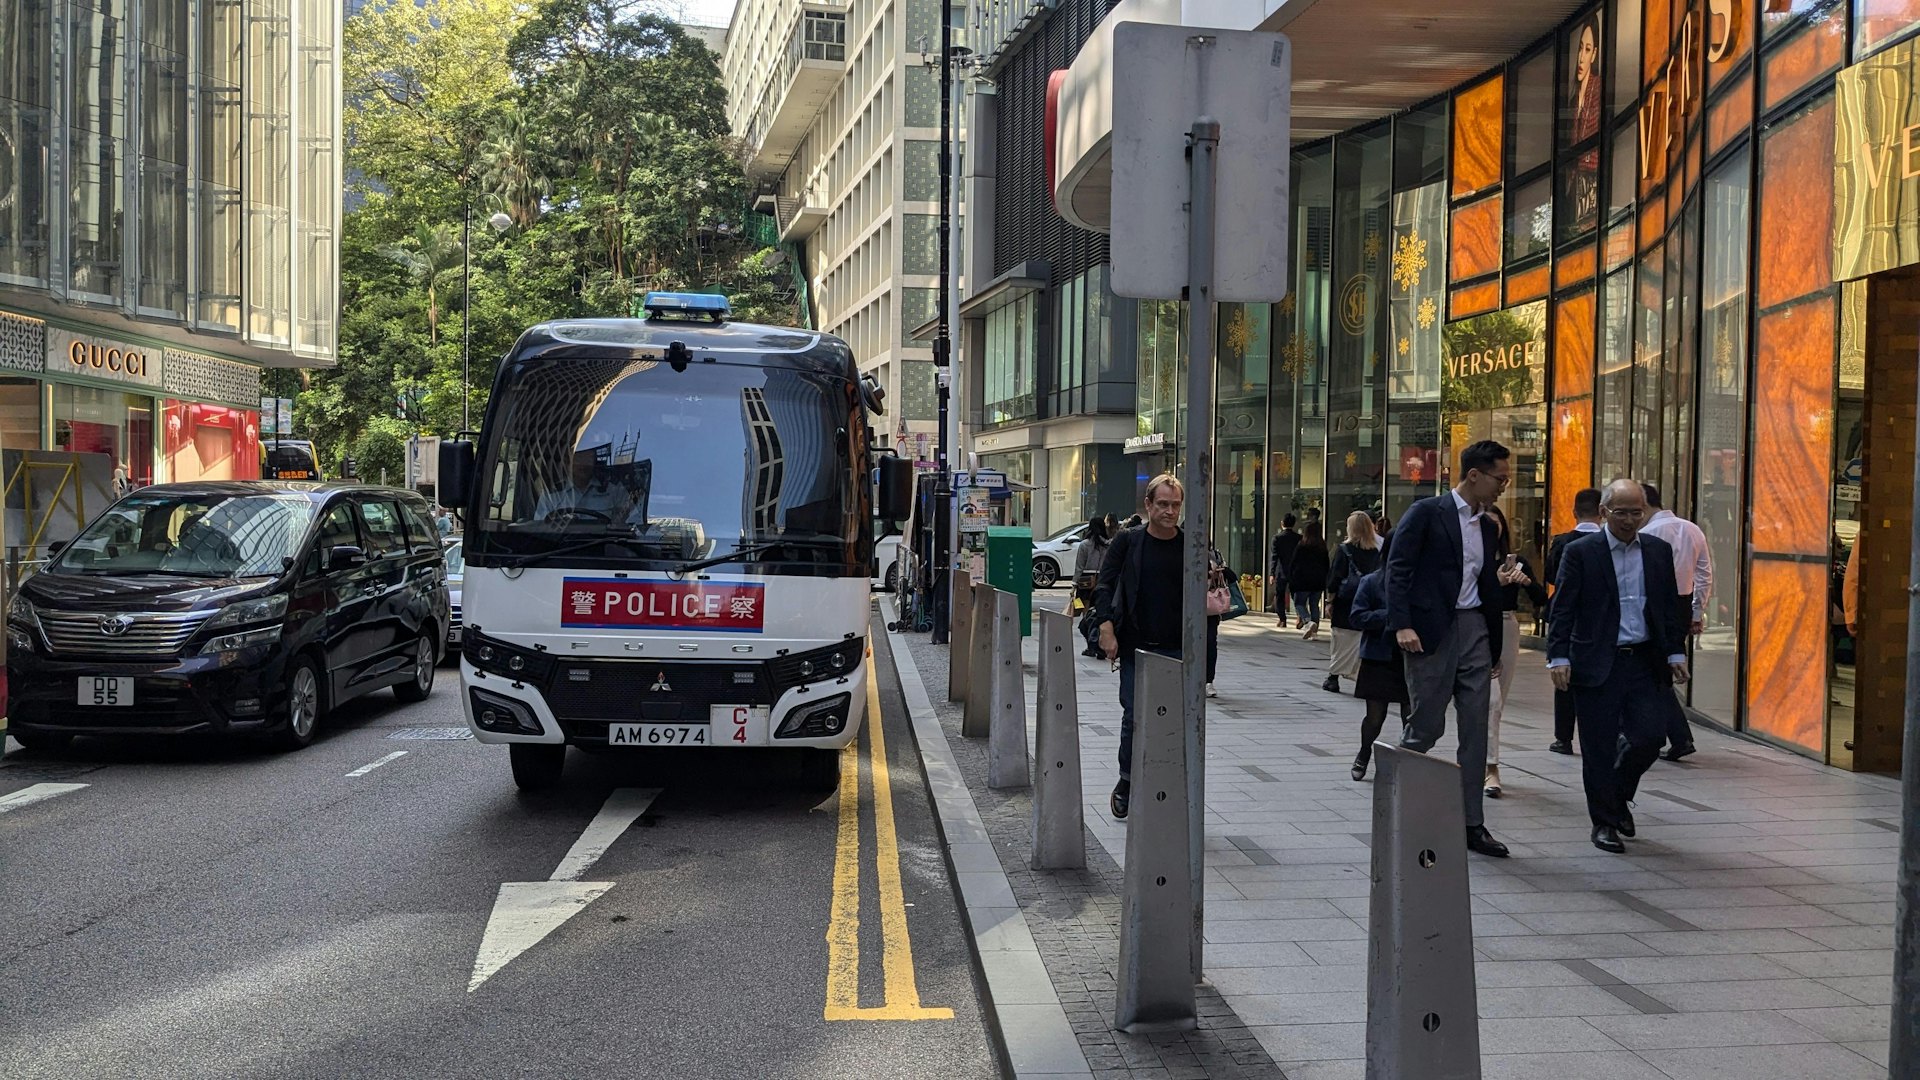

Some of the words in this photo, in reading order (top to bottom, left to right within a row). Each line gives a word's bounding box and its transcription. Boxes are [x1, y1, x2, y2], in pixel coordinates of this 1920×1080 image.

[71, 341, 146, 377] GUCCI
[1449, 341, 1535, 379] VERSACE
[571, 591, 596, 615] 警
[604, 591, 720, 618] POLICE
[730, 595, 756, 619] 察
[571, 642, 753, 652] FUSO
[94, 677, 118, 691] DD
[94, 691, 118, 705] 55
[733, 707, 747, 725] C
[733, 726, 747, 743] 4
